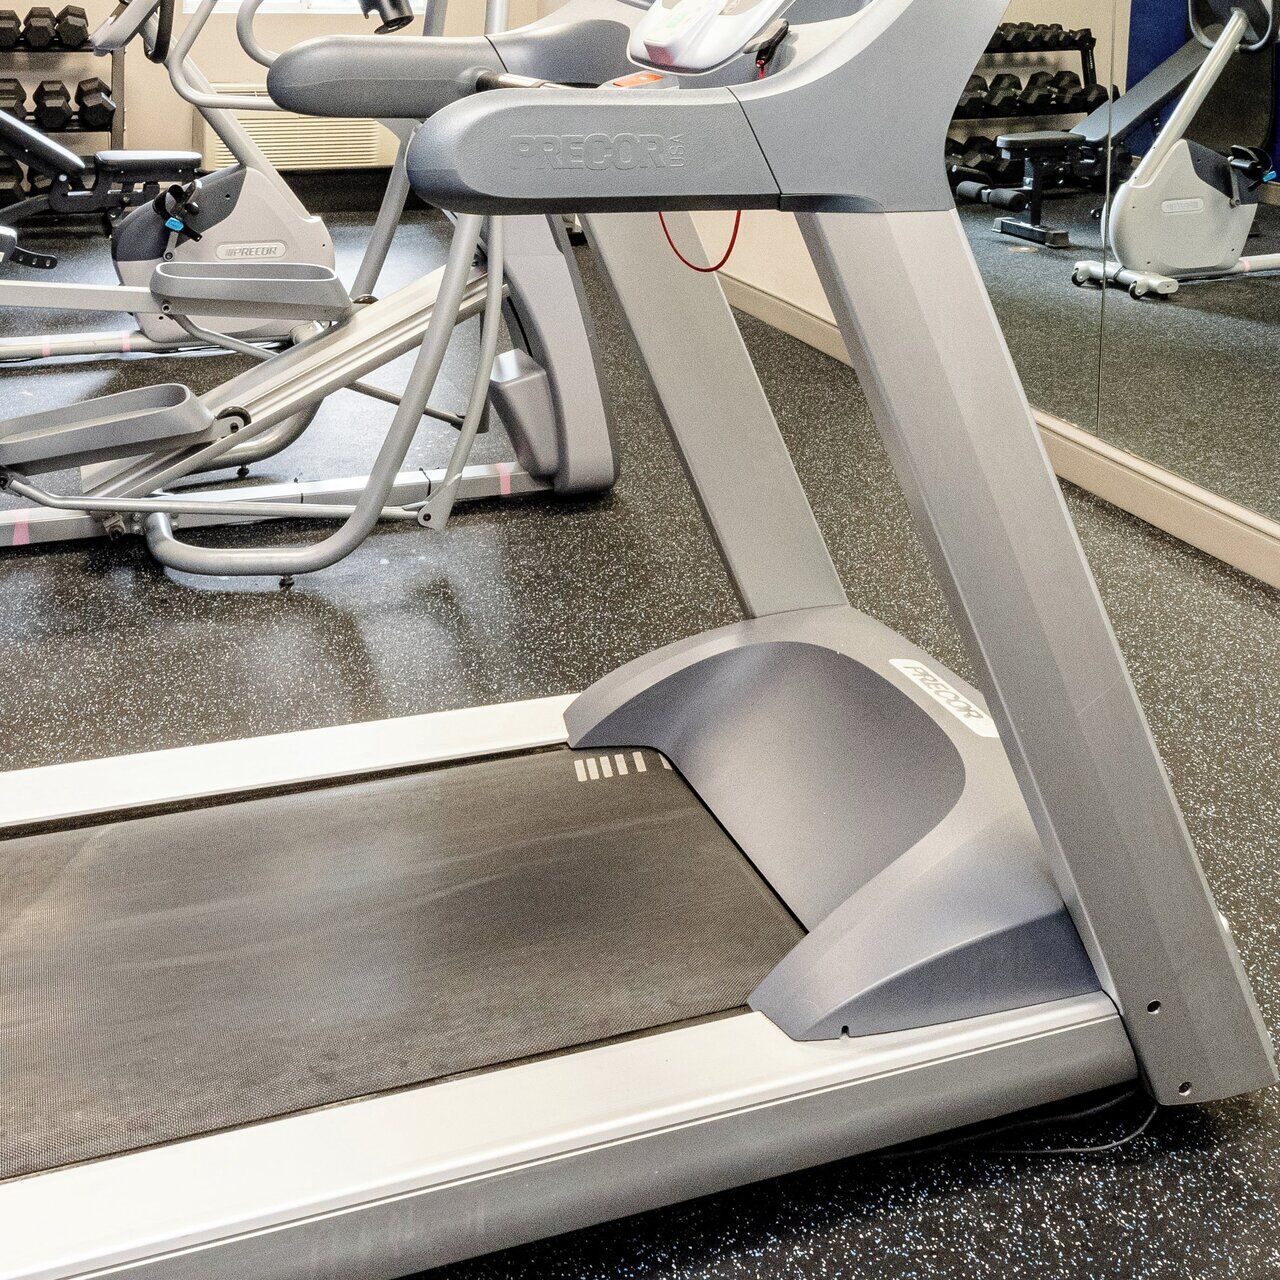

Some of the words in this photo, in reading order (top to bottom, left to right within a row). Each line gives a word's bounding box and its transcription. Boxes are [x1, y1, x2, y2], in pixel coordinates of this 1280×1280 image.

[510, 133, 666, 170] PRECOR
[669, 133, 685, 167] USA
[231, 246, 277, 256] PRECOR
[903, 666, 984, 719] PRECOR
